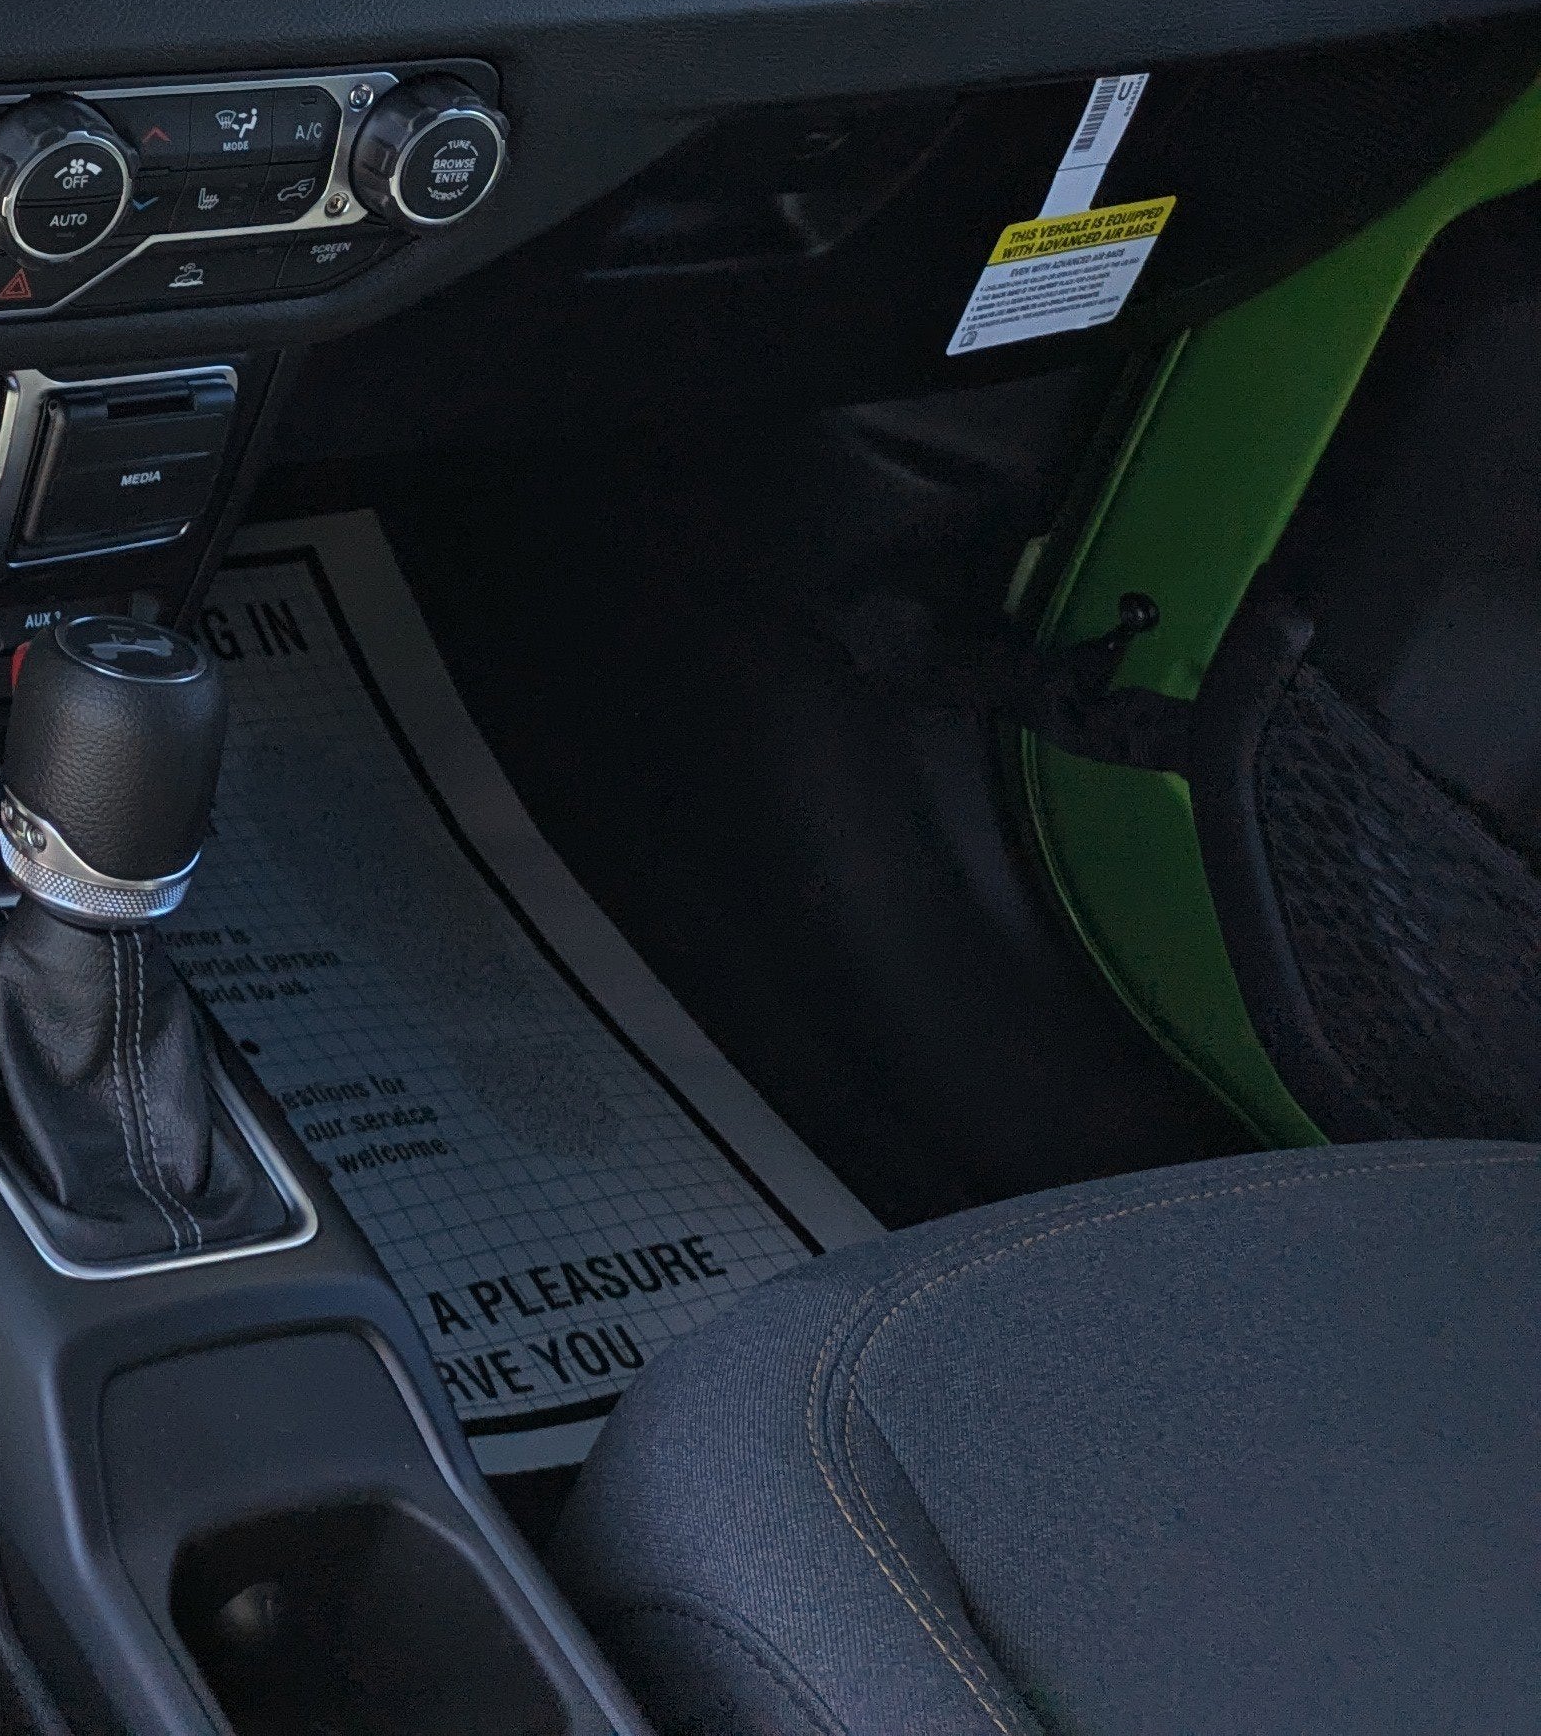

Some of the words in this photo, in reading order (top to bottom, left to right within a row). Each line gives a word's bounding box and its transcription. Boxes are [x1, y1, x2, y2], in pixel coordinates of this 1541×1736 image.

[223, 141, 249, 151] MODE
[432, 158, 476, 171] BROWSE
[62, 173, 88, 188] OFF
[434, 171, 469, 185] ENTER
[50, 212, 87, 226] AUTO
[1009, 229, 1038, 244] THIS
[1040, 218, 1089, 239] VEHICLE
[1105, 206, 1164, 226] EQUIPPED
[1002, 243, 1035, 259] WITH
[1036, 232, 1100, 252] ADVANCED
[1102, 227, 1123, 241] AIR
[1123, 221, 1156, 236] BAGS
[121, 471, 161, 486] MEDIA
[468, 1234, 727, 1326] PLEASURE
[528, 1325, 645, 1382] YOU
